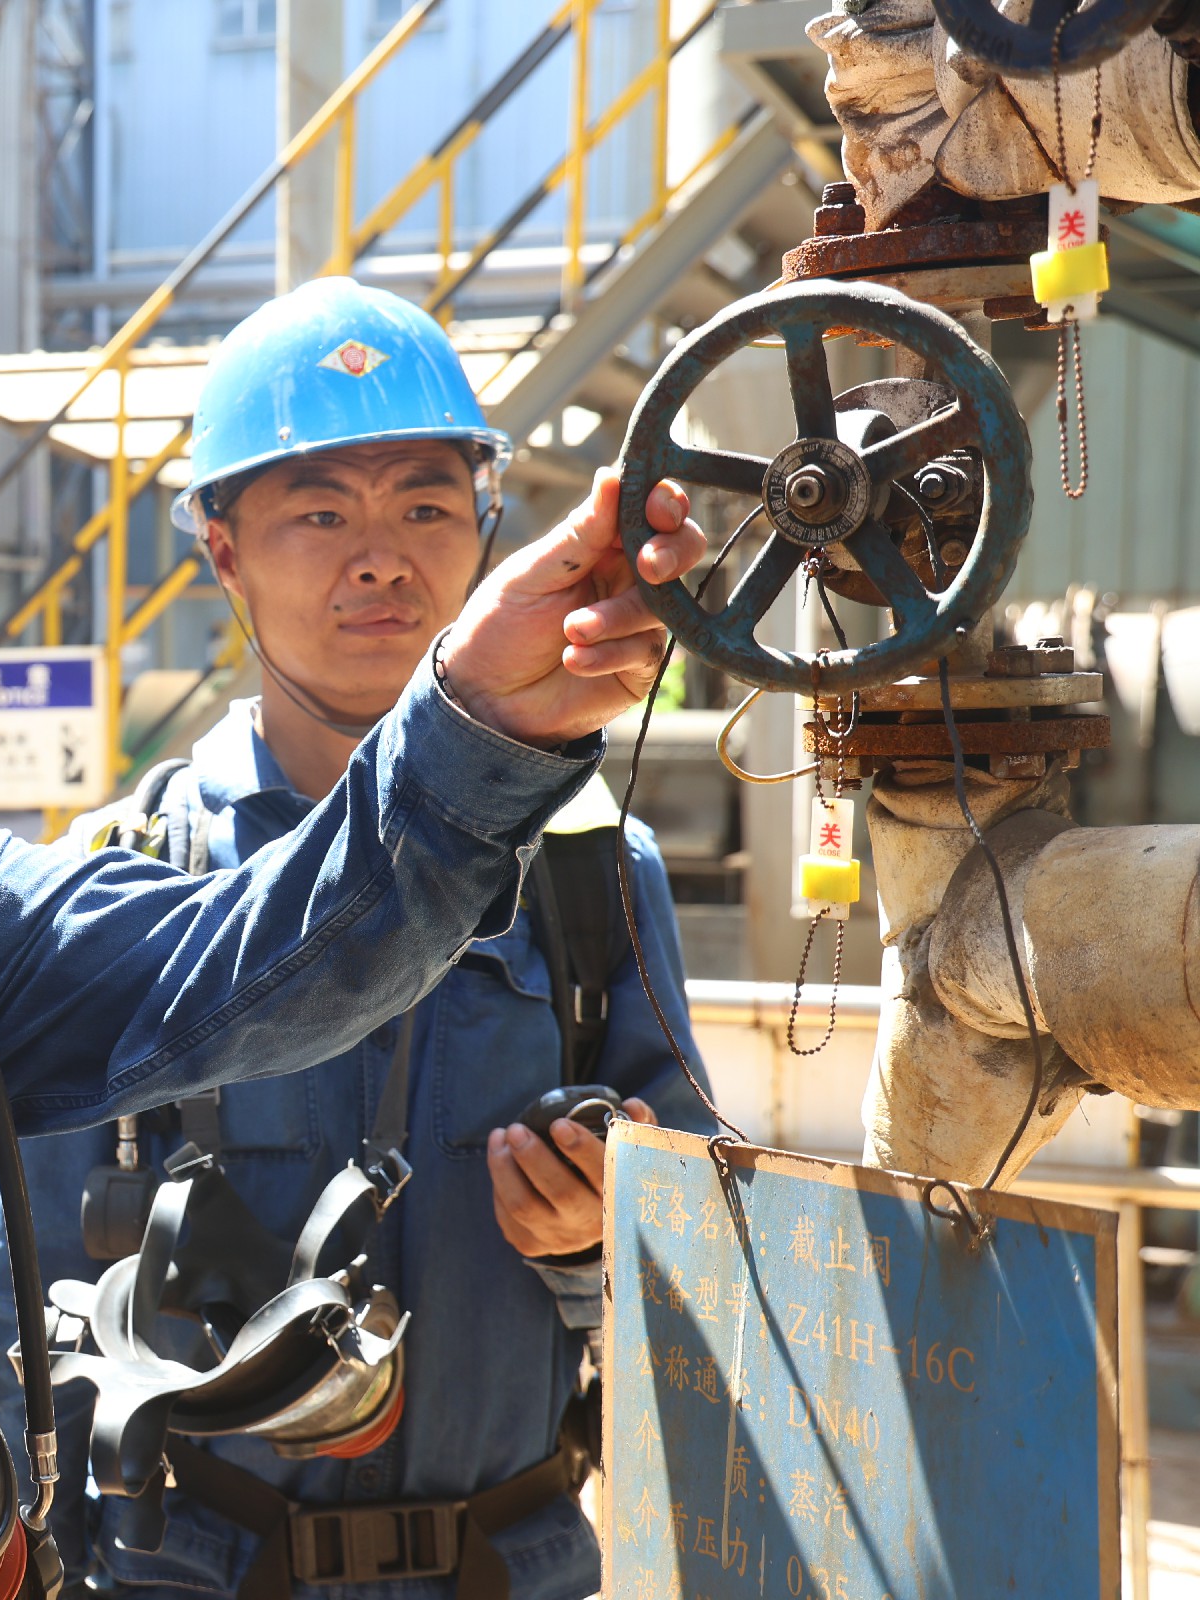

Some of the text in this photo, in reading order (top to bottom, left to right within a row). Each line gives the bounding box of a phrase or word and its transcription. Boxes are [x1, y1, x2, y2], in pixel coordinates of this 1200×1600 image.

[1058, 210, 1085, 241] 关
[818, 849, 841, 857] CLOSE
[819, 823, 841, 849] 关
[788, 1216, 890, 1288] 截止阀
[786, 1303, 976, 1393] Z41H-16C
[786, 1384, 880, 1452] DN40
[788, 1468, 856, 1541] 蒸汽
